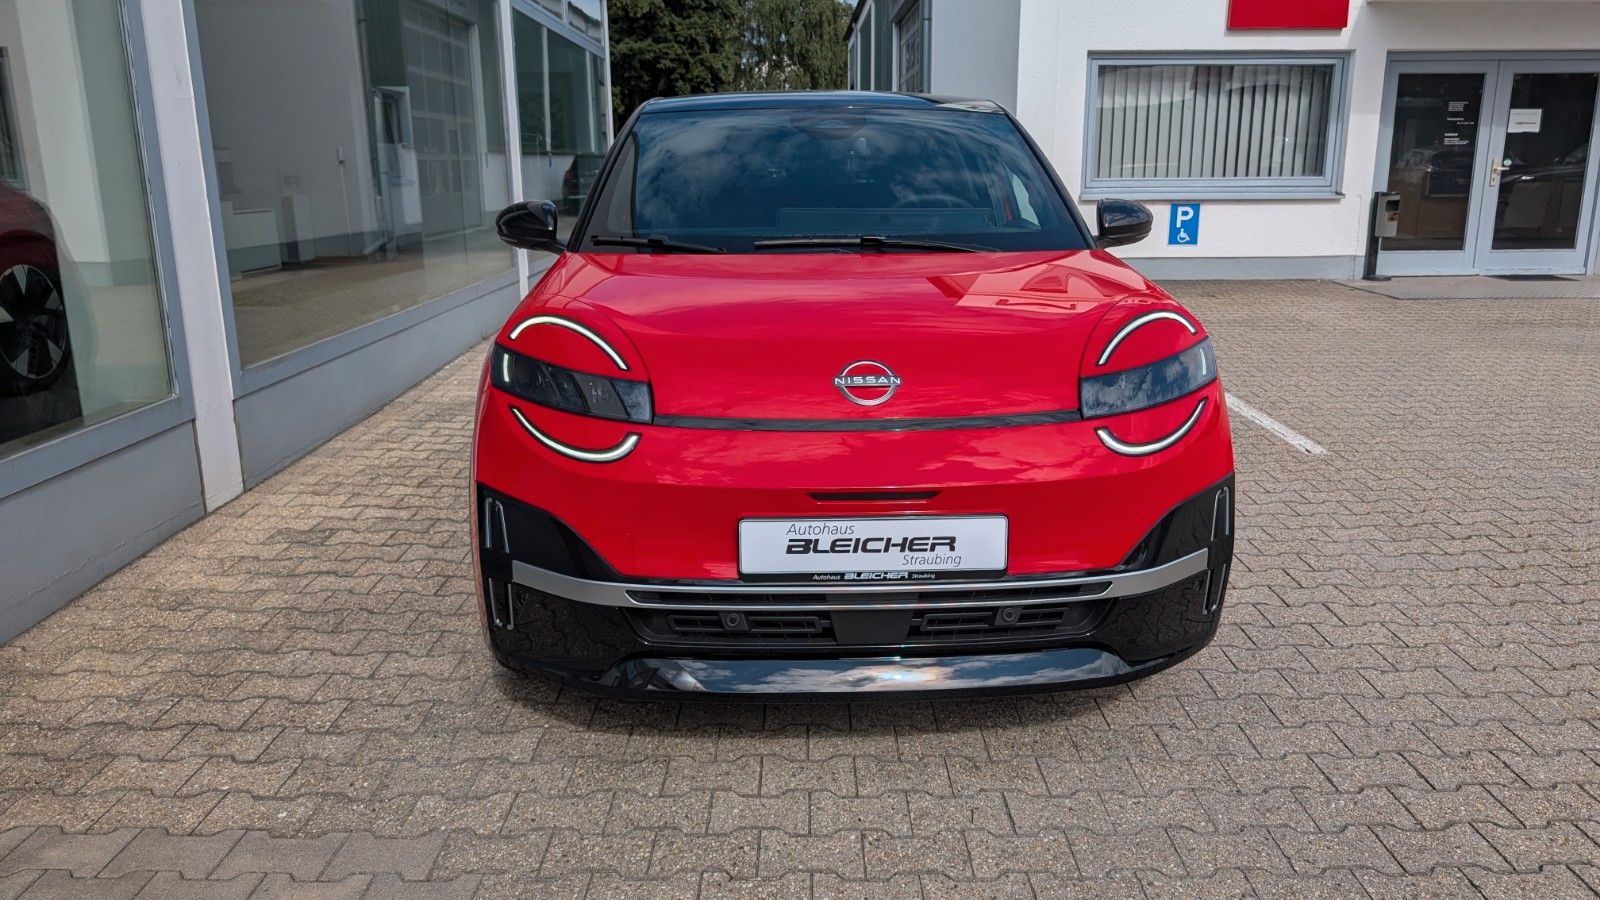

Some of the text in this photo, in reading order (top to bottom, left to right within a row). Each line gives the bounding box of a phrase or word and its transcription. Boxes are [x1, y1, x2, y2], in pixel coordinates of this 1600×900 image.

[1176, 206, 1194, 228] P
[834, 376, 901, 385] NISSAN
[786, 522, 855, 536] Autohaus
[785, 536, 957, 555] BLEICHER
[902, 554, 962, 567] Straubing
[812, 571, 936, 581] Autohaus BLEICHER Straubing
